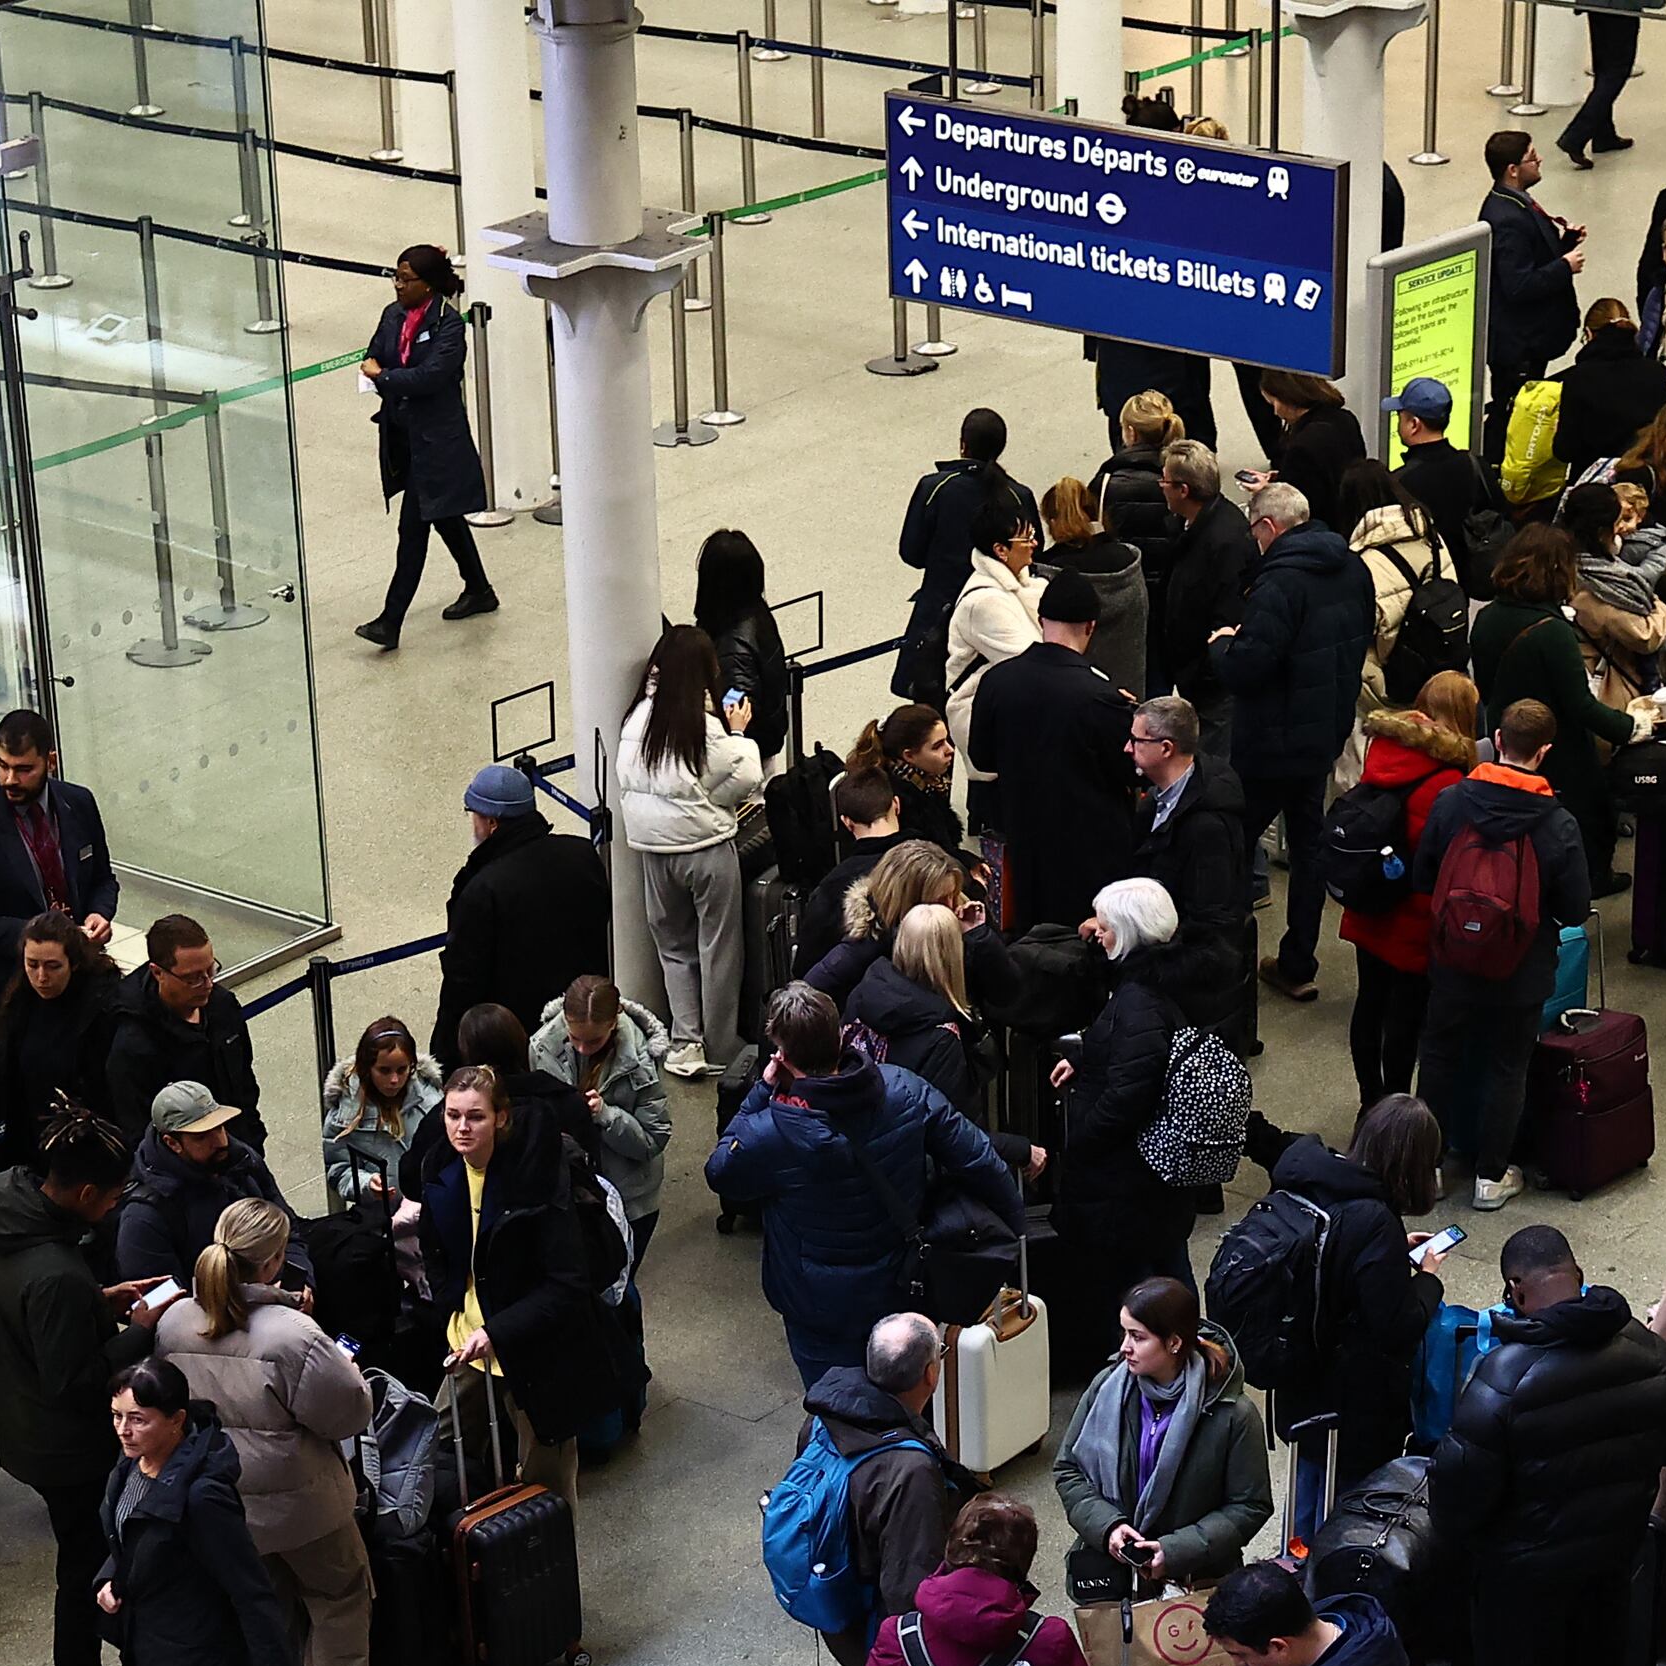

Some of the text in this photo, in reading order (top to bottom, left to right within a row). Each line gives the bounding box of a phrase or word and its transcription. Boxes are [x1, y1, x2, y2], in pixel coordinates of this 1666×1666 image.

[934, 112, 1260, 189] Departures Départs eurostar
[934, 165, 1089, 218] Underground
[936, 216, 1257, 299] International tickets Billets
